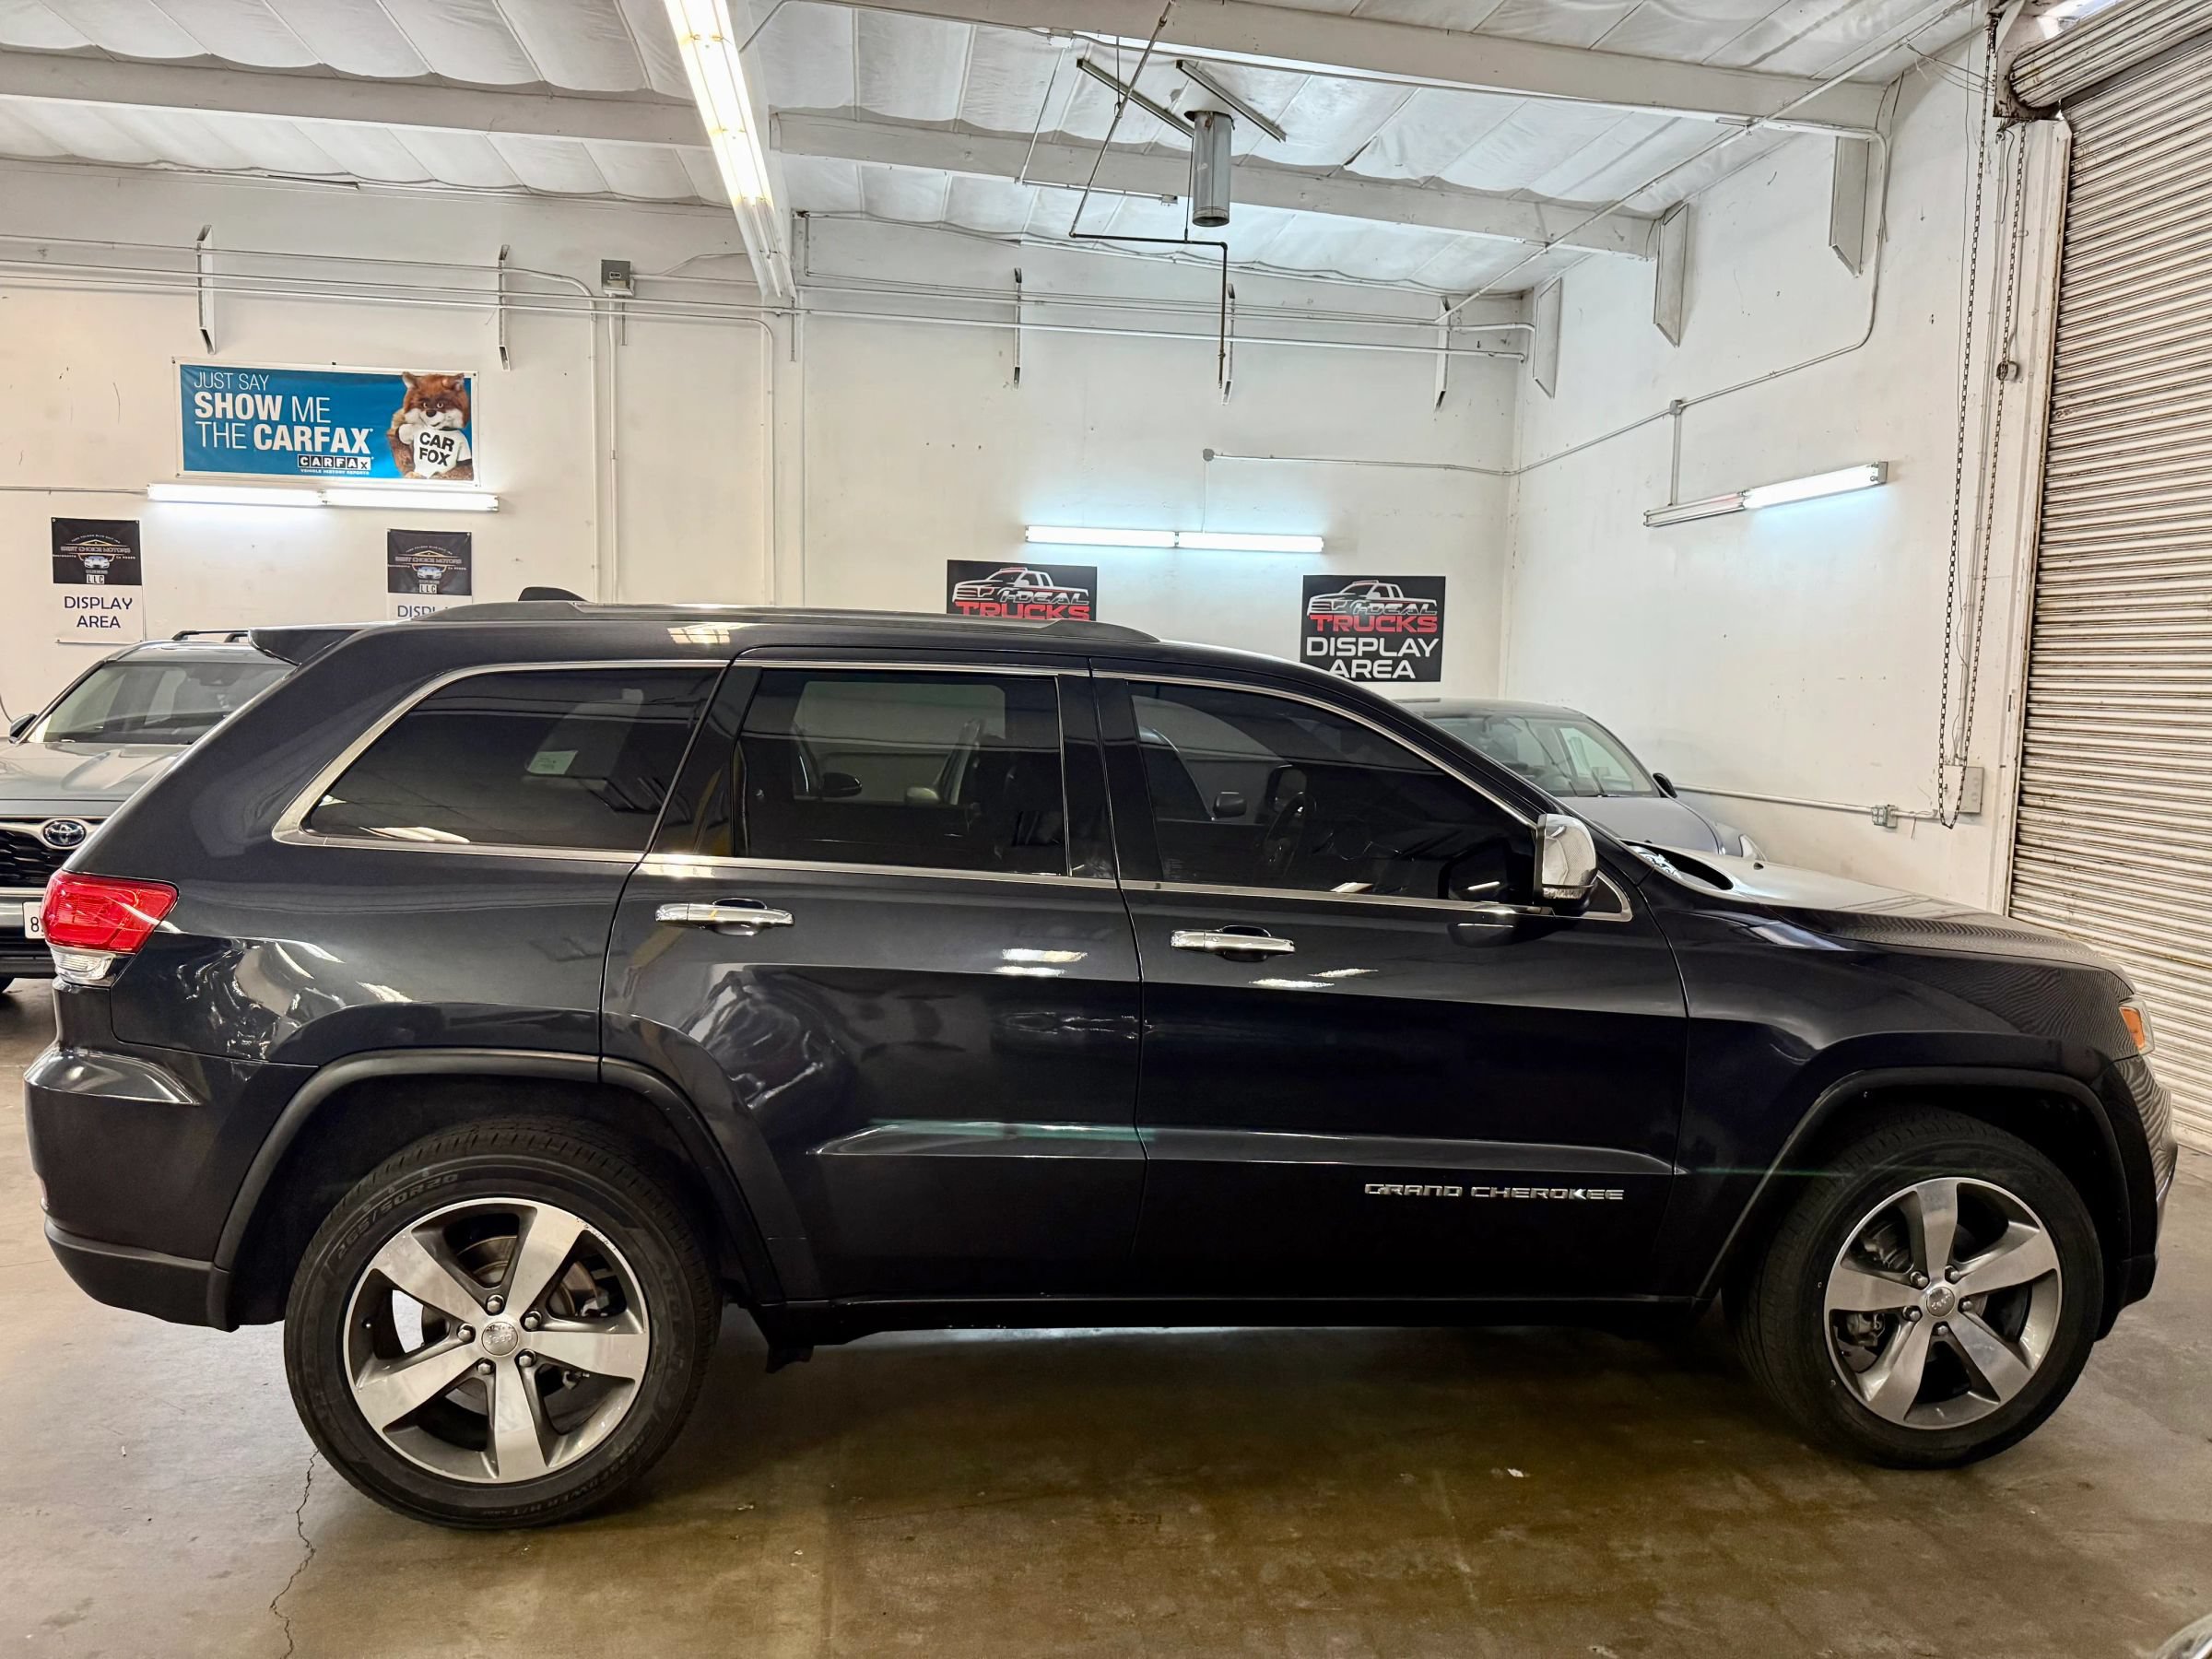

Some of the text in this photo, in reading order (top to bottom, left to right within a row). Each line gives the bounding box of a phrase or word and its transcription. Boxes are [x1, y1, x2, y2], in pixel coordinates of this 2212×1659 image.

[194, 371, 269, 391] JUST SAY
[194, 391, 332, 423] SHOW ME
[194, 421, 371, 453] THE CARFAX
[419, 431, 454, 453] CAR
[300, 455, 369, 470] CARFAX
[418, 446, 451, 467] FOX
[64, 595, 133, 610] DISPLAY
[954, 601, 1092, 621] TRUCKS
[76, 615, 122, 629] AREA
[1309, 614, 1438, 633] TRUCKS
[1306, 636, 1440, 657] DISPLAY
[1329, 659, 1417, 679] AREA
[1364, 1183, 1625, 1200] GRAND CHEROKEE
